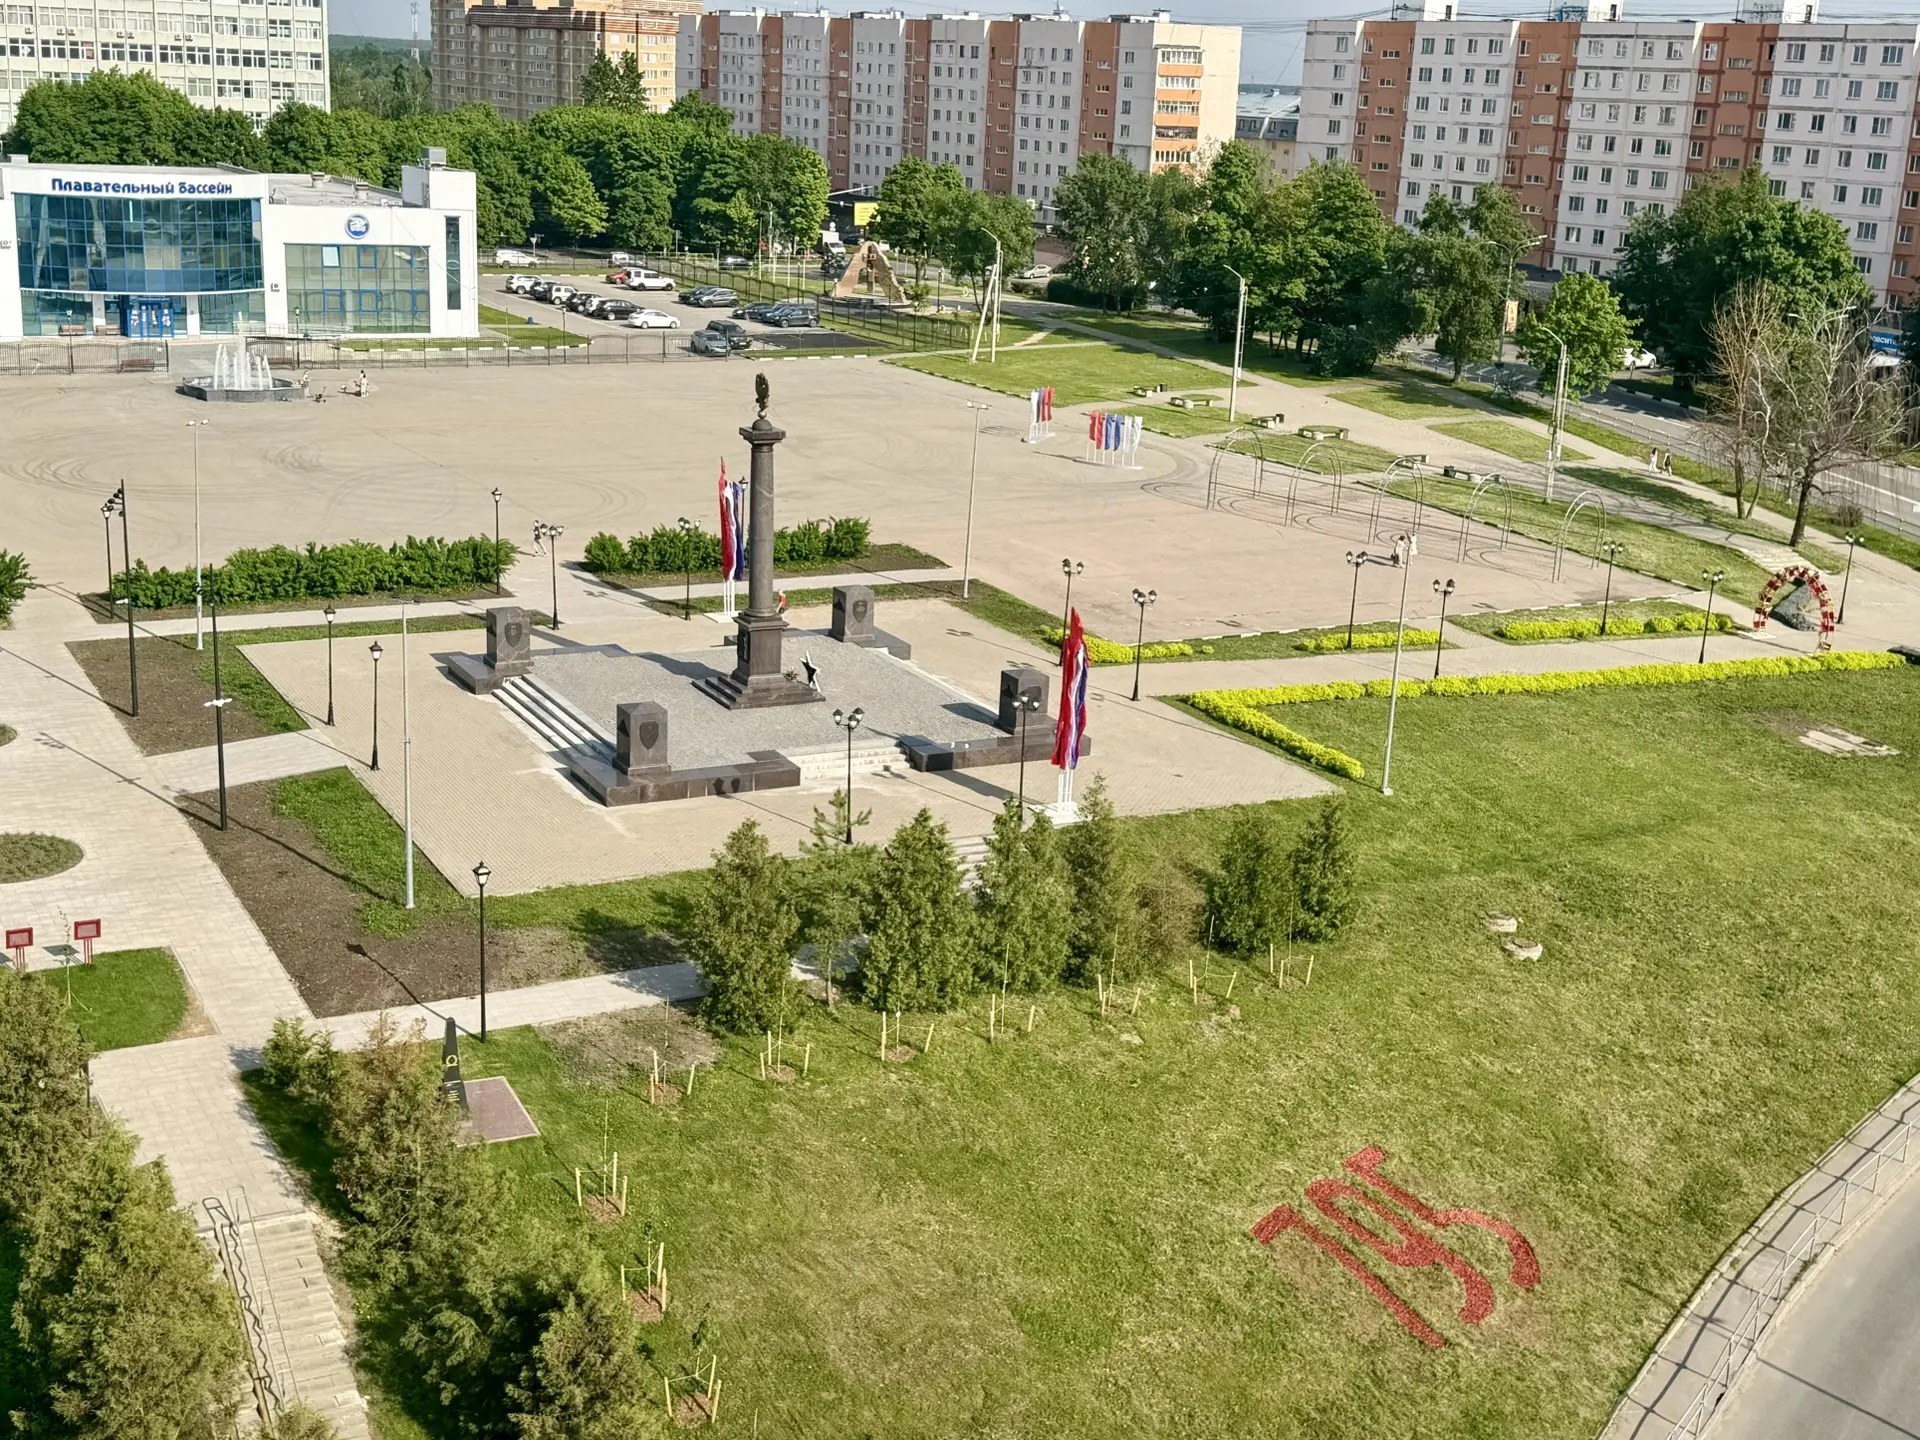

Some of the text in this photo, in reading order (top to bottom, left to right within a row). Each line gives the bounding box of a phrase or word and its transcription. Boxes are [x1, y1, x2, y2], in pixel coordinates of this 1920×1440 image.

[51, 178, 233, 195] Плавательный бассейн
[1250, 1145, 1541, 1349] 195
